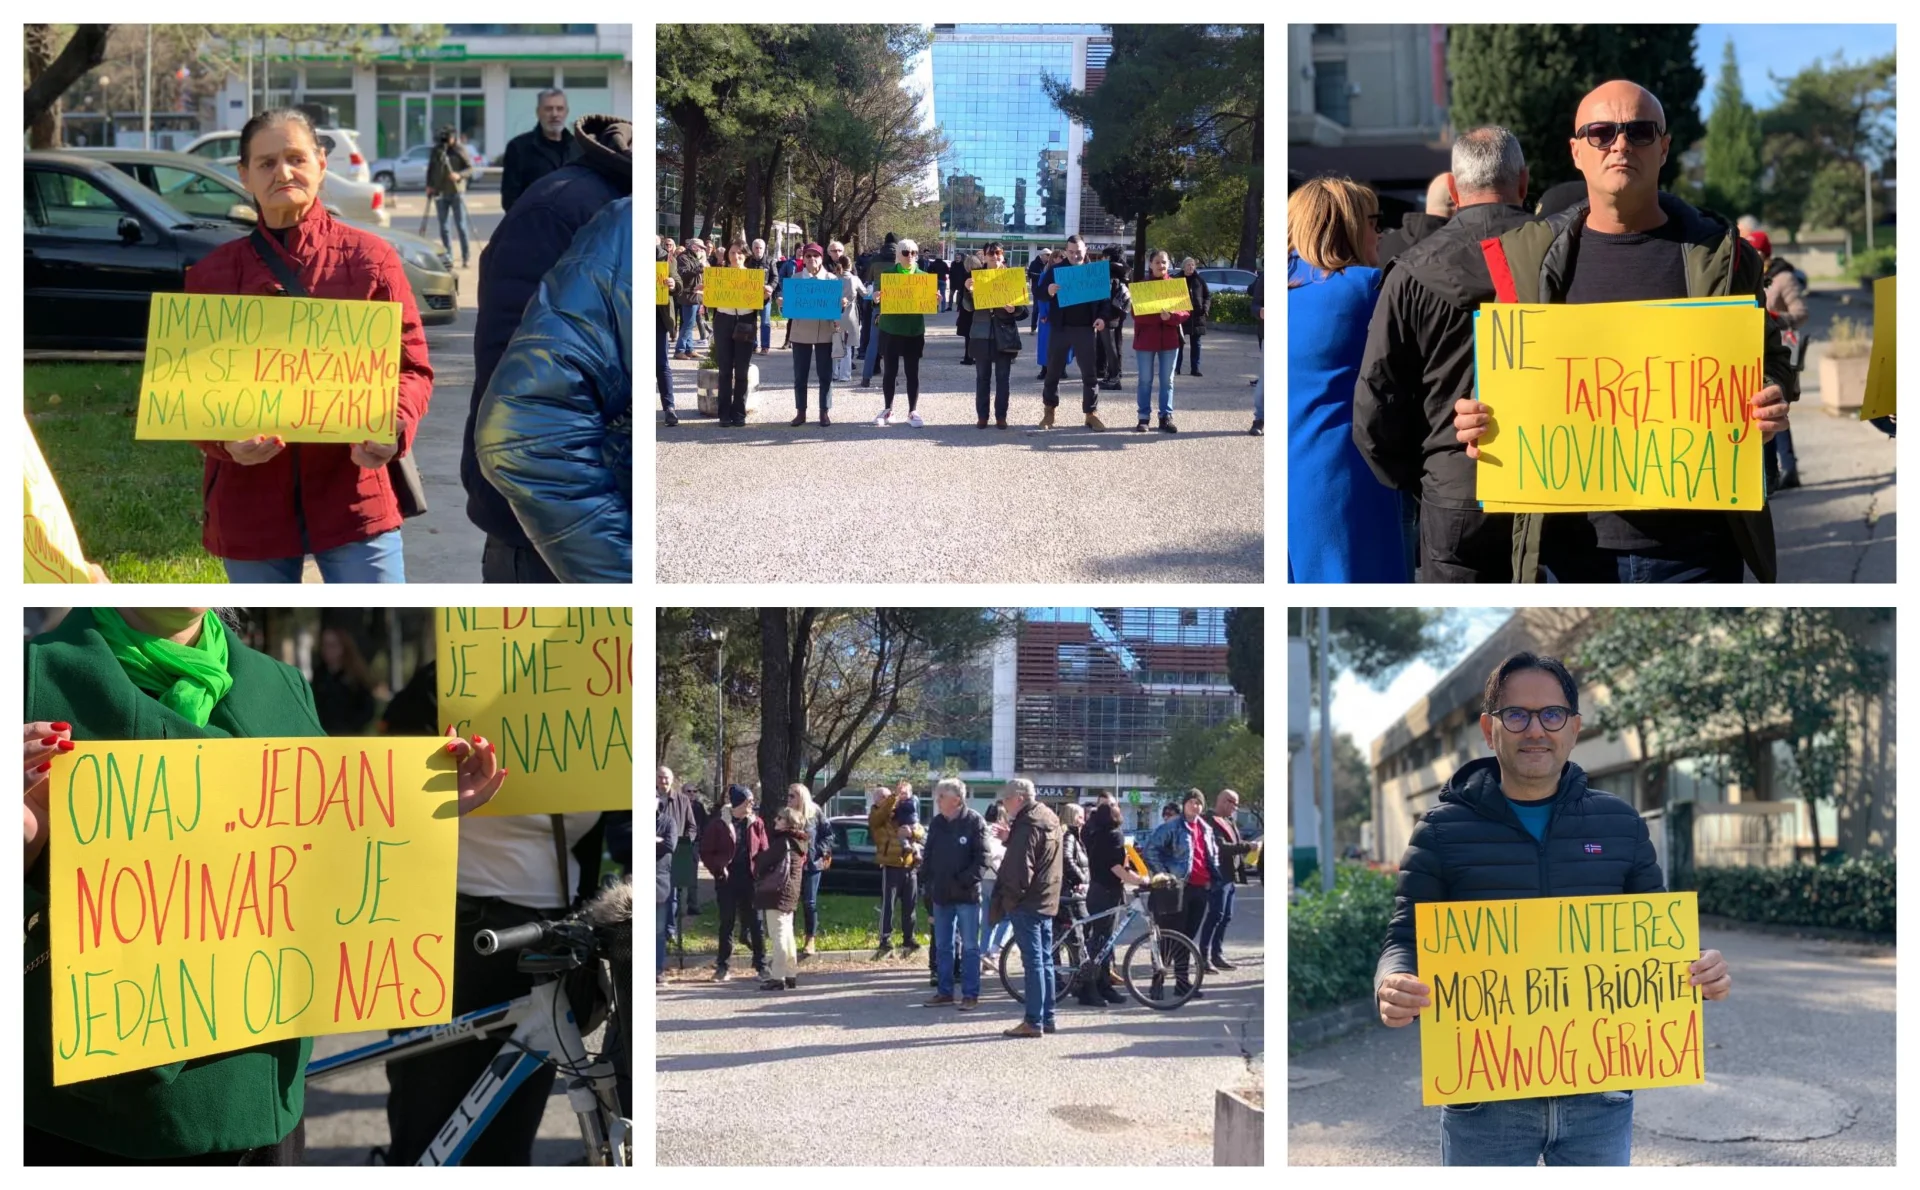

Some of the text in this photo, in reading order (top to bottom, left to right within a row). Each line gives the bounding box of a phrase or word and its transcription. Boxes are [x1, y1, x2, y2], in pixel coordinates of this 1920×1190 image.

[157, 296, 393, 349] IMAMO PRAVO
[1491, 308, 1547, 370] NE
[151, 345, 398, 387] DA SE IZRAŽAVAMO
[147, 388, 188, 430] NA
[446, 636, 632, 697] JE IME SI
[67, 744, 203, 845] ONAJ
[335, 836, 411, 926] JE
[1423, 900, 1685, 956] JAVNI INTERES
[58, 932, 447, 1061] JEDAN OD NAS
[1433, 968, 1515, 1025] MORA
[1434, 1009, 1701, 1096] JAVNOG SERVISA
